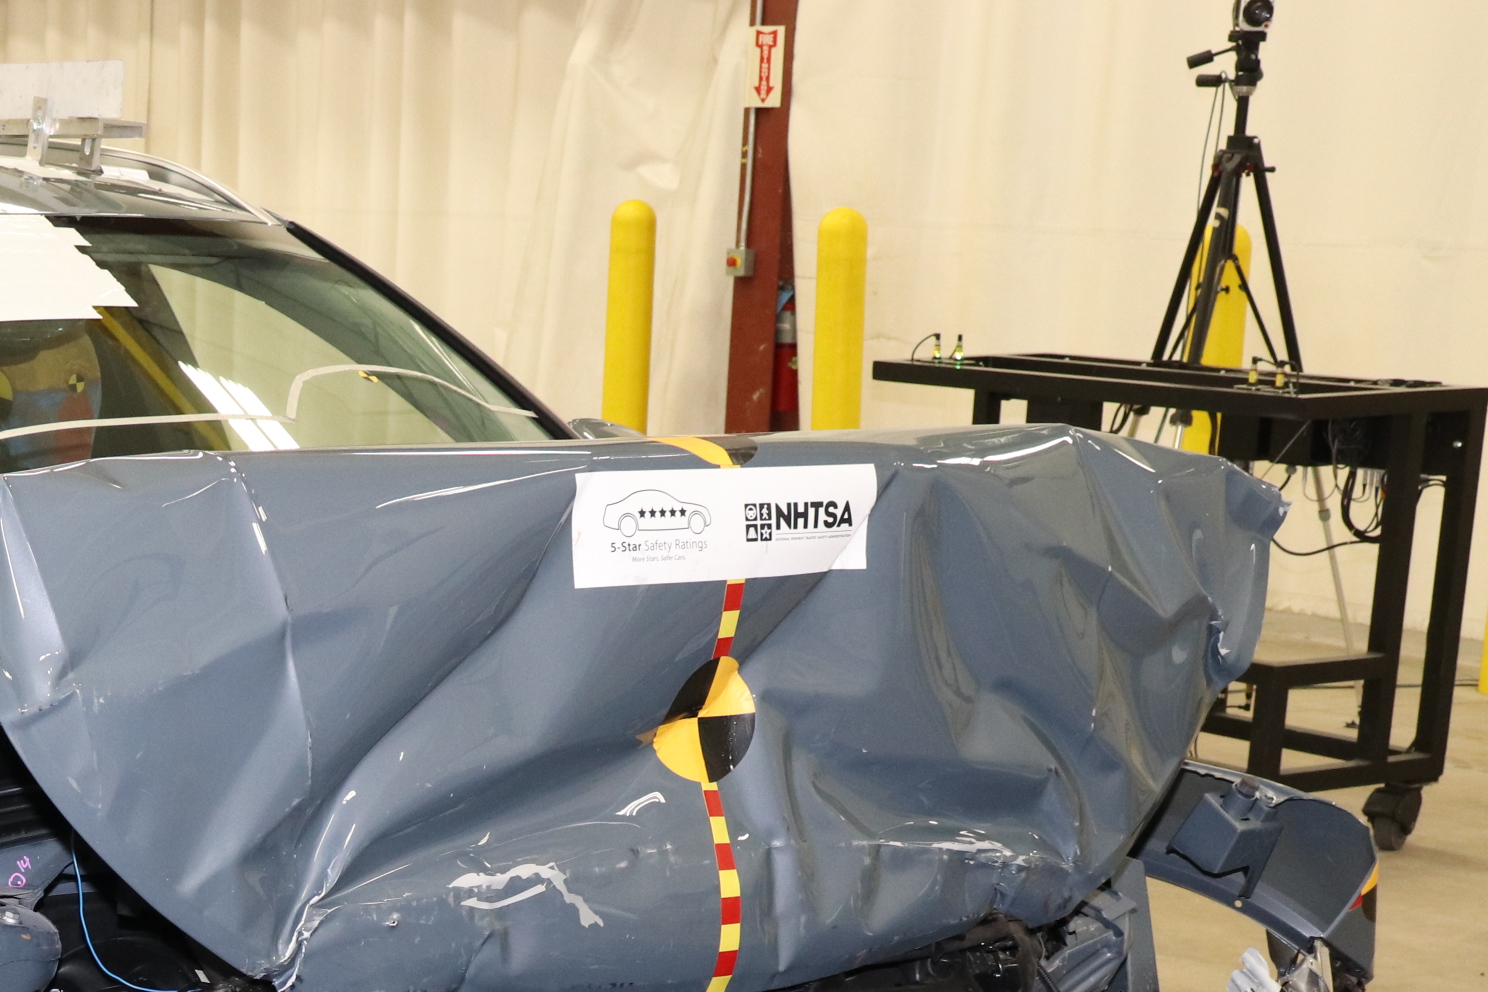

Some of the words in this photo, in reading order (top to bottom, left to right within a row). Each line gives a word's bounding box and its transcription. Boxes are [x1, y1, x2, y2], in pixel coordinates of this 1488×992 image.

[775, 500, 853, 530] NHTSA
[611, 541, 641, 553] 5-Star
[644, 539, 672, 553] Safety
[675, 538, 708, 552] Ratings
[16, 855, 32, 872] 14
